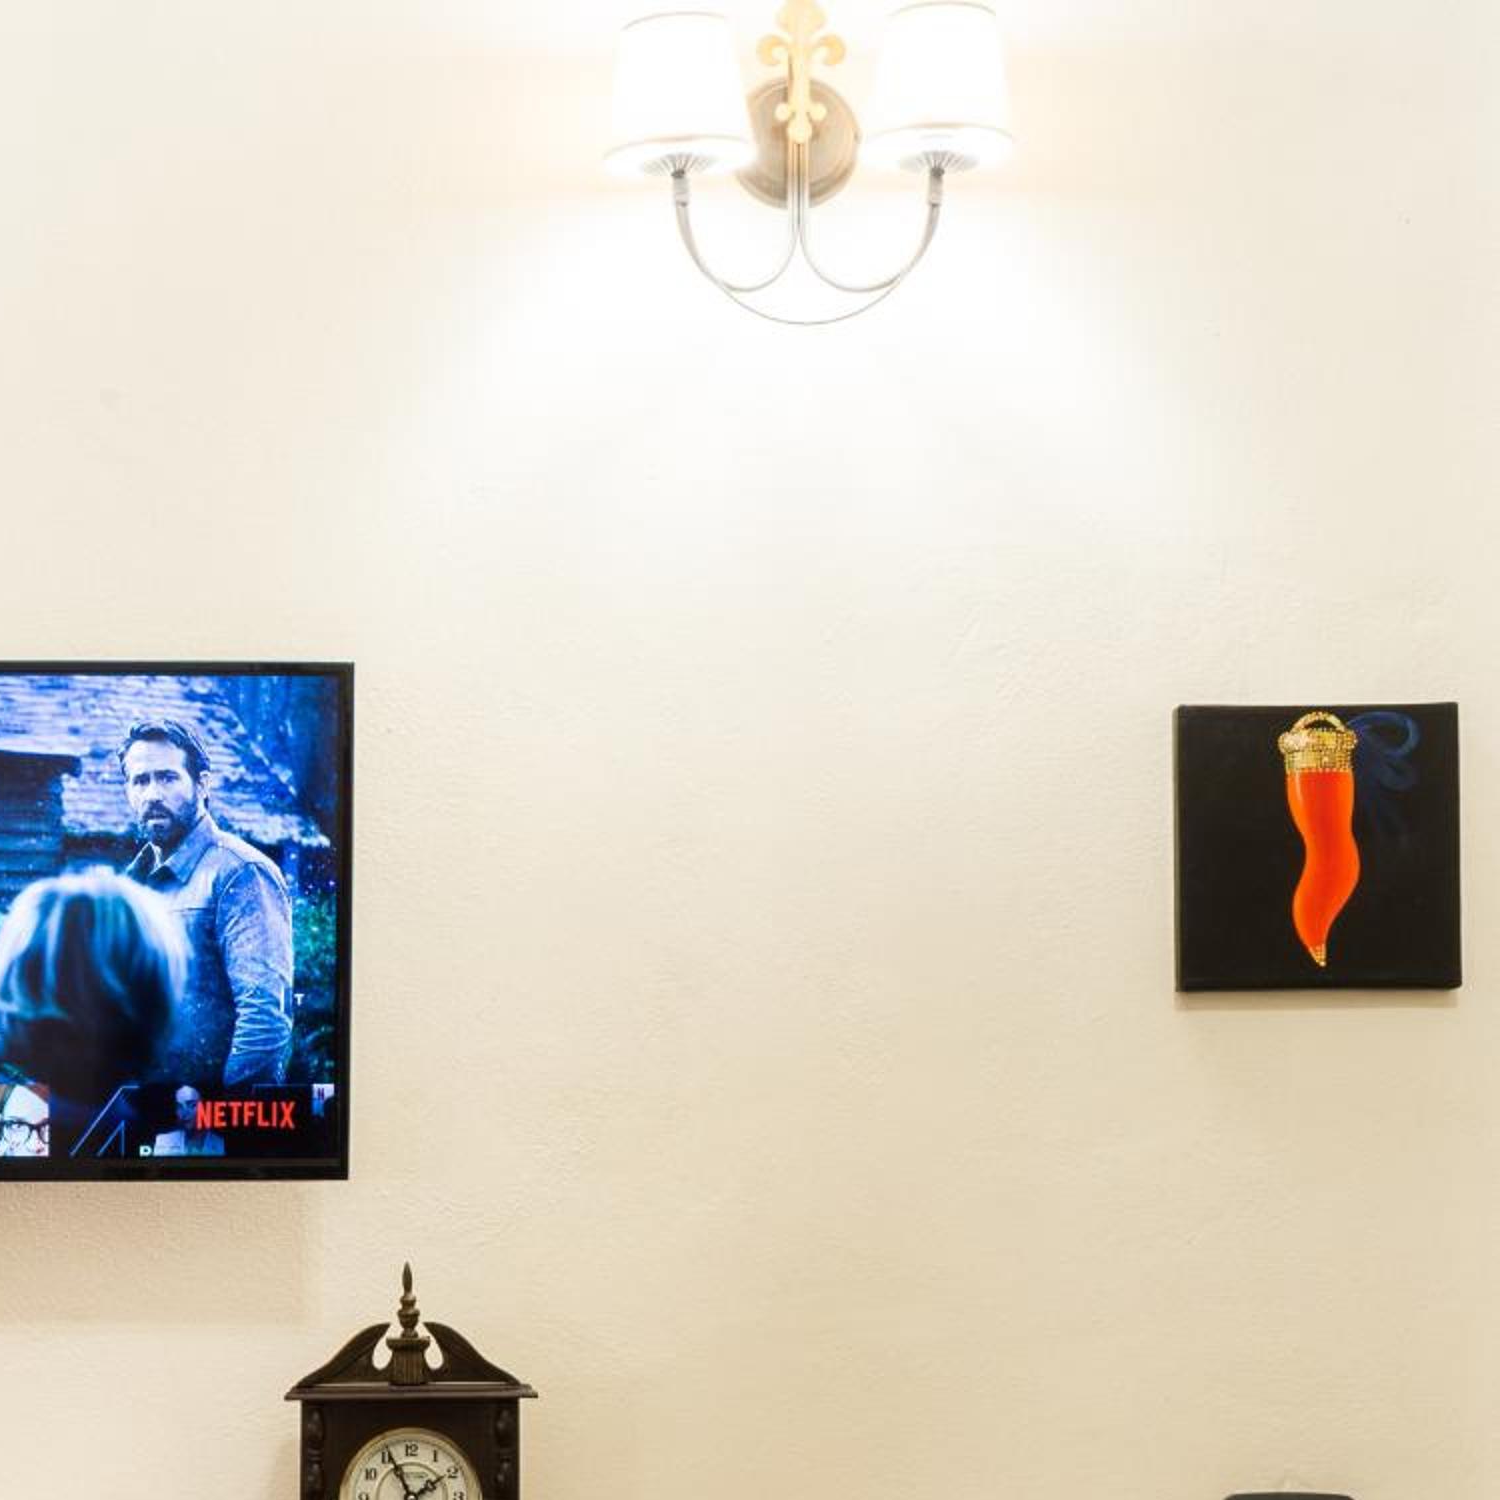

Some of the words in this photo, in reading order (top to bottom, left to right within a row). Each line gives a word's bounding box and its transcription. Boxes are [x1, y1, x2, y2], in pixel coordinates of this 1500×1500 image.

[196, 1101, 295, 1130] NETFLIX
[404, 1443, 419, 1457] 12
[433, 1450, 438, 1462] 1
[365, 1468, 377, 1480] 10
[446, 1467, 459, 1479] 2
